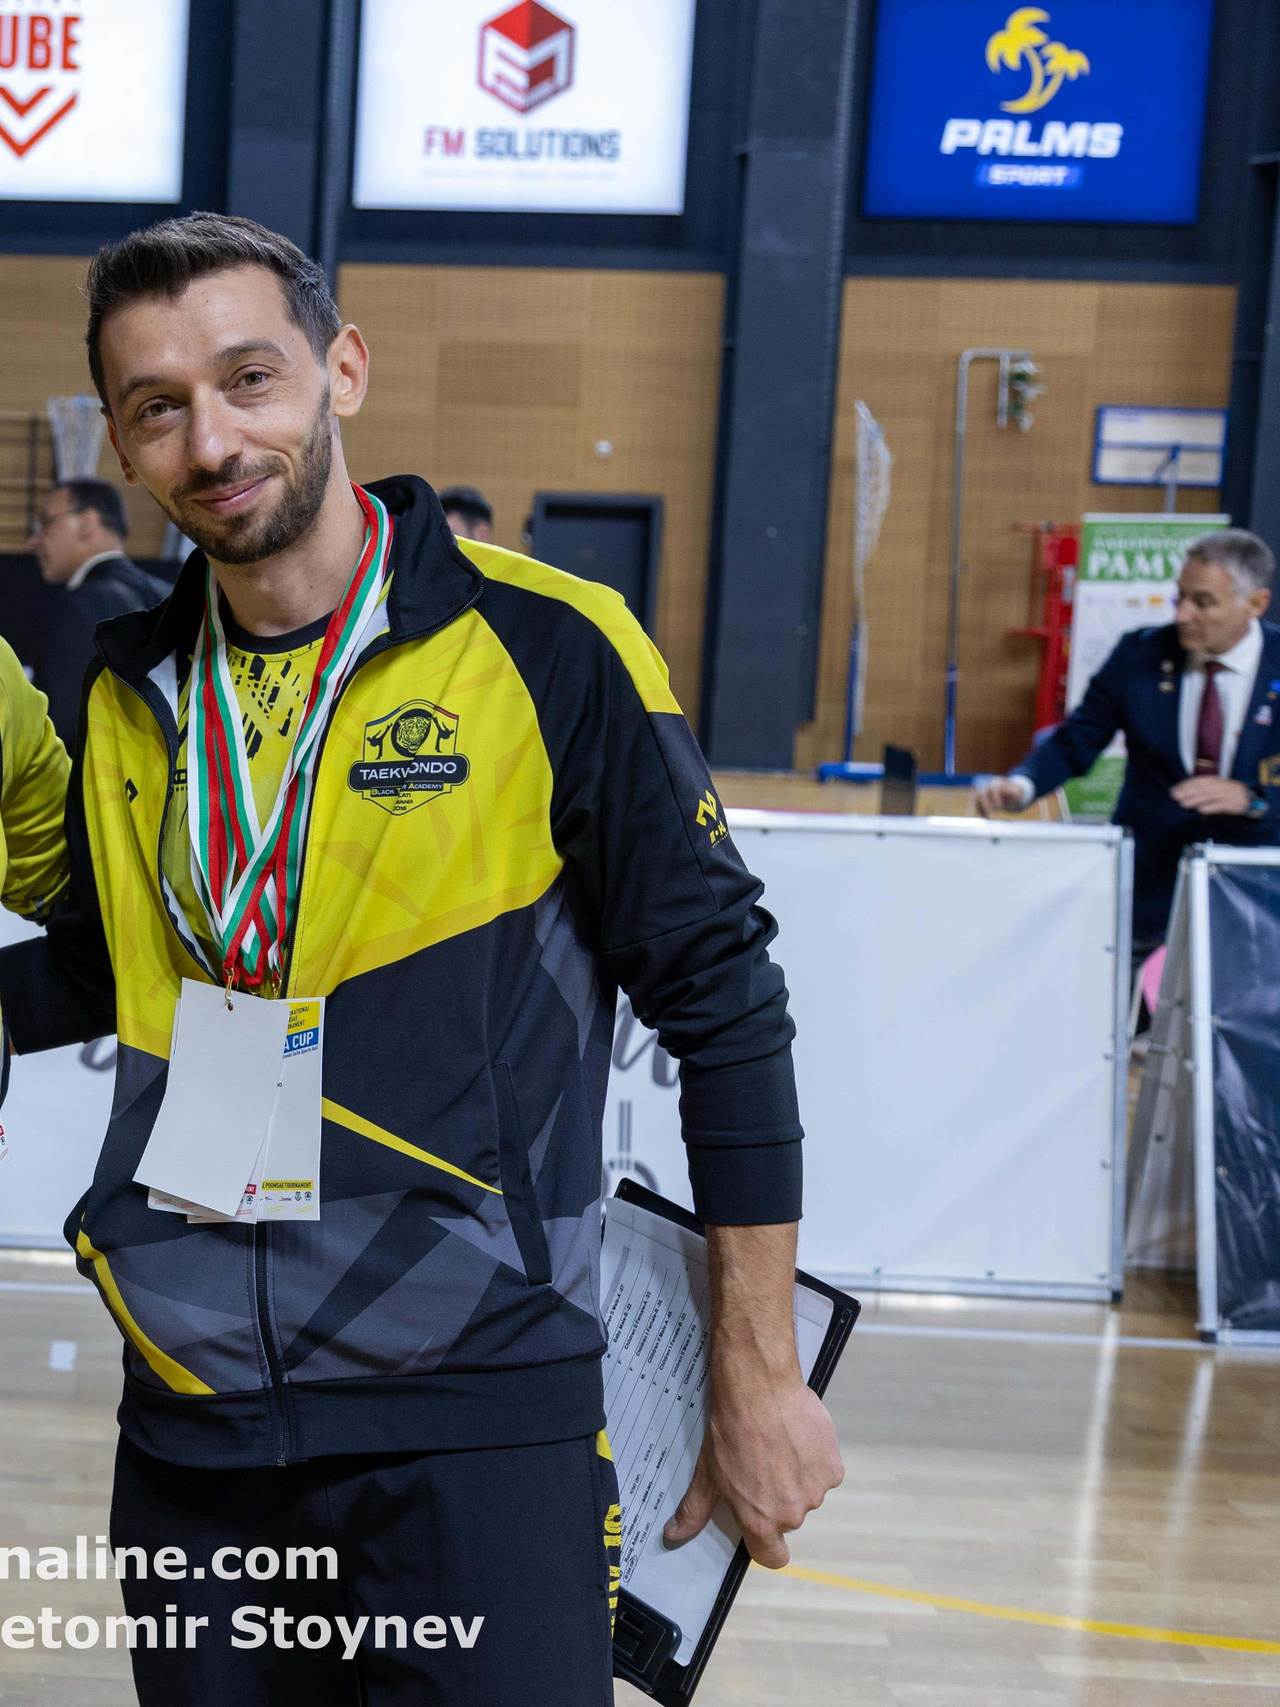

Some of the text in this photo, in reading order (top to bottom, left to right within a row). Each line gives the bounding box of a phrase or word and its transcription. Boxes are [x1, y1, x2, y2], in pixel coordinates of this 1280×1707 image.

[475, 128, 620, 160] SOLUTIONS
[940, 118, 1124, 159] PALMS
[987, 163, 1069, 187] SPORT
[292, 1031, 314, 1049] CUP
[613, 1330, 622, 1343] Baby
[619, 1312, 628, 1330] Male-B
[624, 1329, 636, 1350] Children
[636, 1301, 648, 1324] Female-A
[635, 1335, 648, 1356] Children
[647, 1309, 659, 1332] Female-B
[647, 1342, 659, 1363] Children
[659, 1320, 669, 1338] Male-A
[659, 1349, 671, 1371] Children
[670, 1322, 682, 1346] Female-B
[671, 1355, 683, 1377] Children
[682, 1334, 692, 1352] Male-B
[684, 1362, 696, 1384] Children
[695, 1341, 705, 1358] Male-A
[696, 1370, 708, 1392] Children
[631, 1530, 641, 1547] Adam
